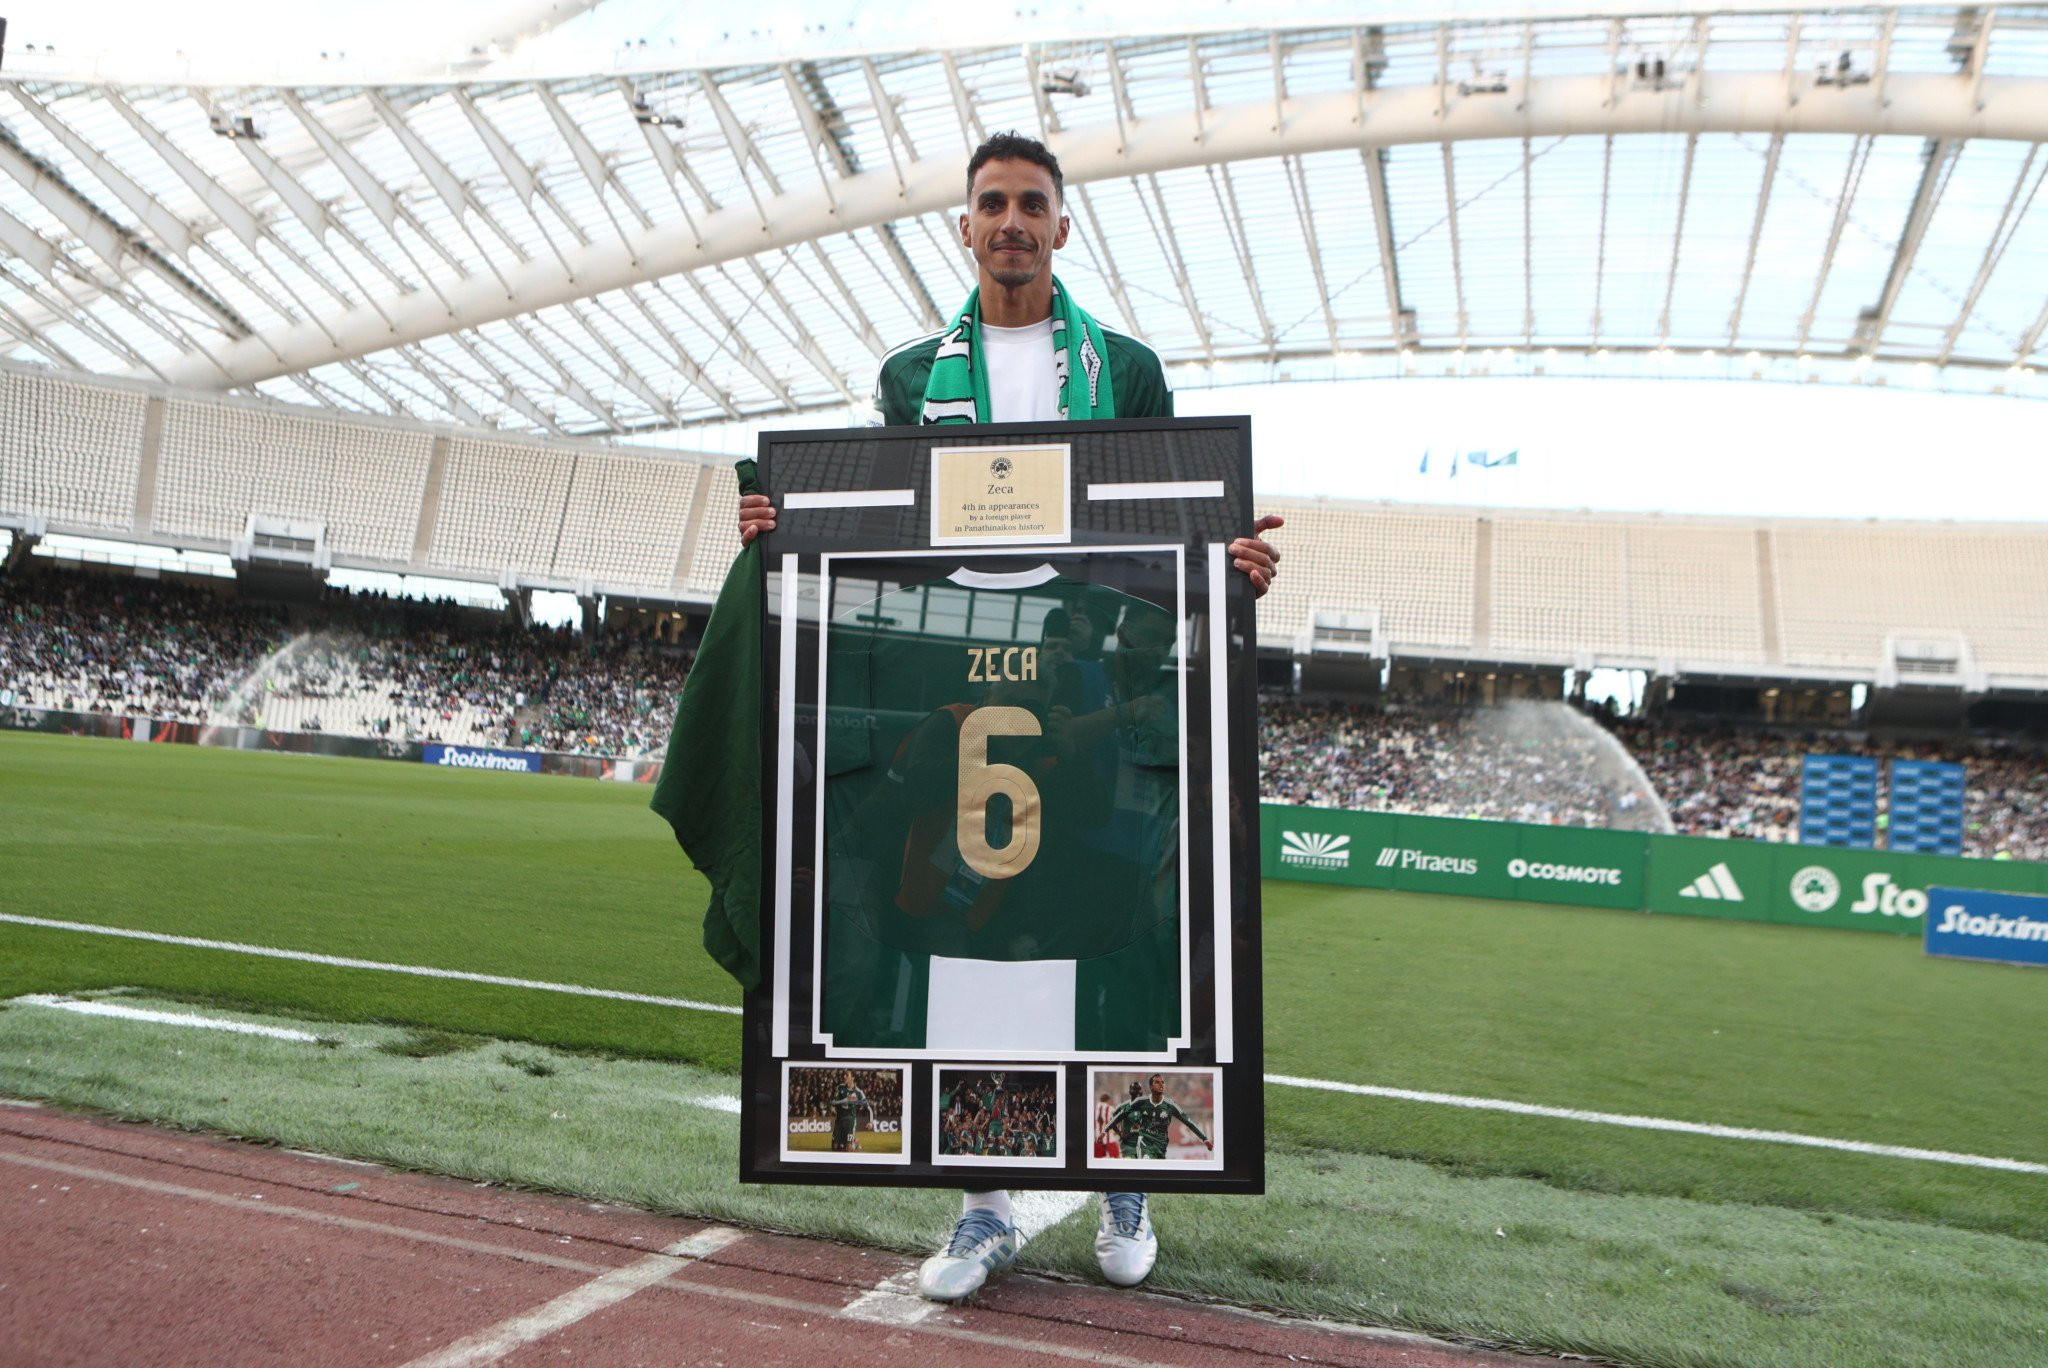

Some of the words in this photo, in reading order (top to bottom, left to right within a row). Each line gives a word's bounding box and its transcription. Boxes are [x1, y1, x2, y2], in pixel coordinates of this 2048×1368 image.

[987, 484, 1014, 495] Zeca
[961, 503, 976, 511] 4th
[978, 503, 987, 511] in
[988, 502, 1040, 512] appearances
[985, 513, 1009, 521] foreign
[1010, 513, 1032, 521] player
[964, 523, 1017, 532] Panathinaikos
[1018, 522, 1047, 532] history
[967, 646, 1038, 683] ZECA
[438, 746, 528, 772] Stoiximan
[957, 706, 1042, 880] 6
[1401, 849, 1478, 875] Piraeus
[1528, 862, 1622, 885] COSMOTE
[1850, 872, 1930, 918] Sto
[789, 1118, 832, 1133] adidas
